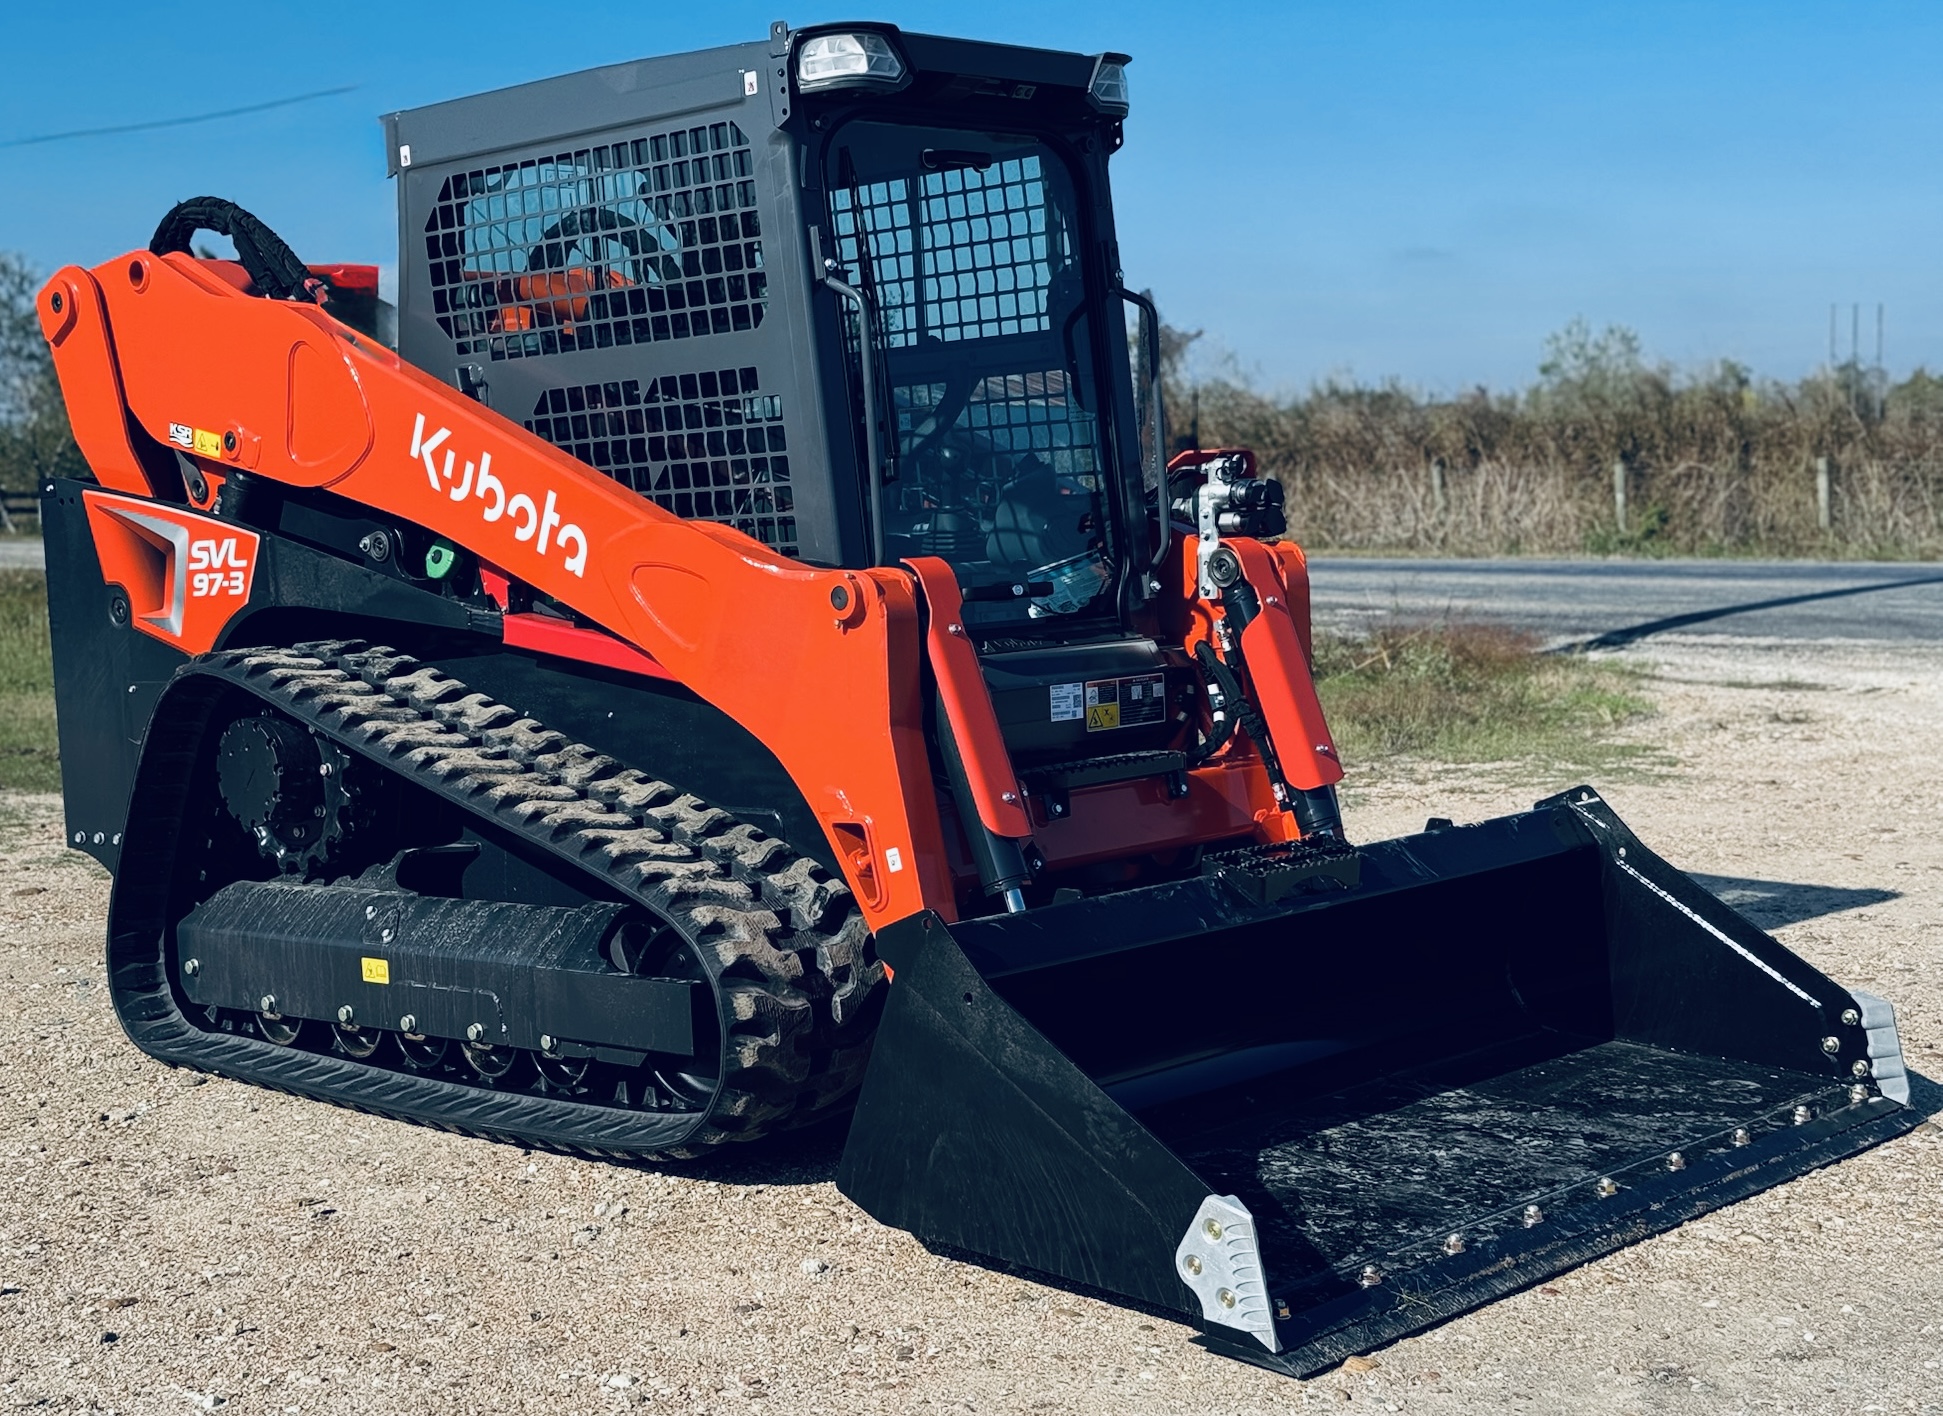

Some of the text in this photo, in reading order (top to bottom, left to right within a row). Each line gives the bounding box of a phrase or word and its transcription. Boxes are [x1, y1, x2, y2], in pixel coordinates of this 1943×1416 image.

[410, 412, 588, 578] Kubota
[189, 538, 247, 570] SVL
[193, 571, 245, 597] 97-3
